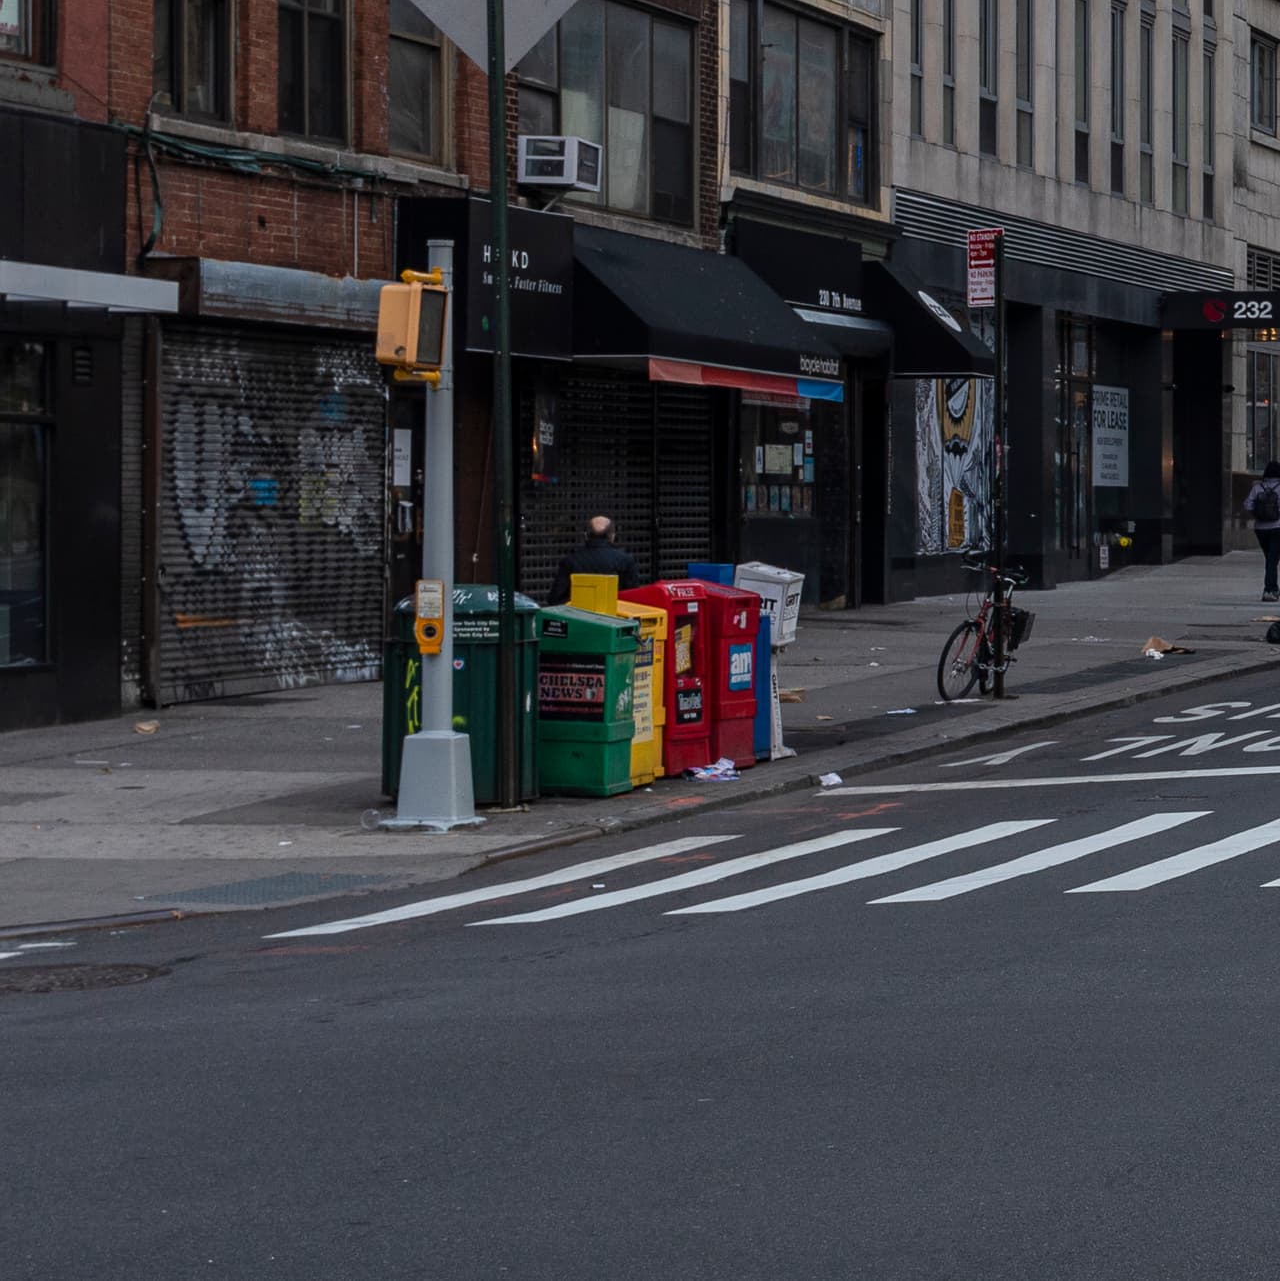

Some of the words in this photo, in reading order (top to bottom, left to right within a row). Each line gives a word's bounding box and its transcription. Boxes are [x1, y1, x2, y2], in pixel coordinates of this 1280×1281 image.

[1233, 301, 1273, 319] 232
[1093, 409, 1107, 430] FOR
[1107, 410, 1127, 431] LEASE
[760, 597, 778, 611] RIT
[785, 592, 800, 607] GRIT
[540, 675, 604, 687] CHELSEA
[540, 687, 583, 700] NEWS
